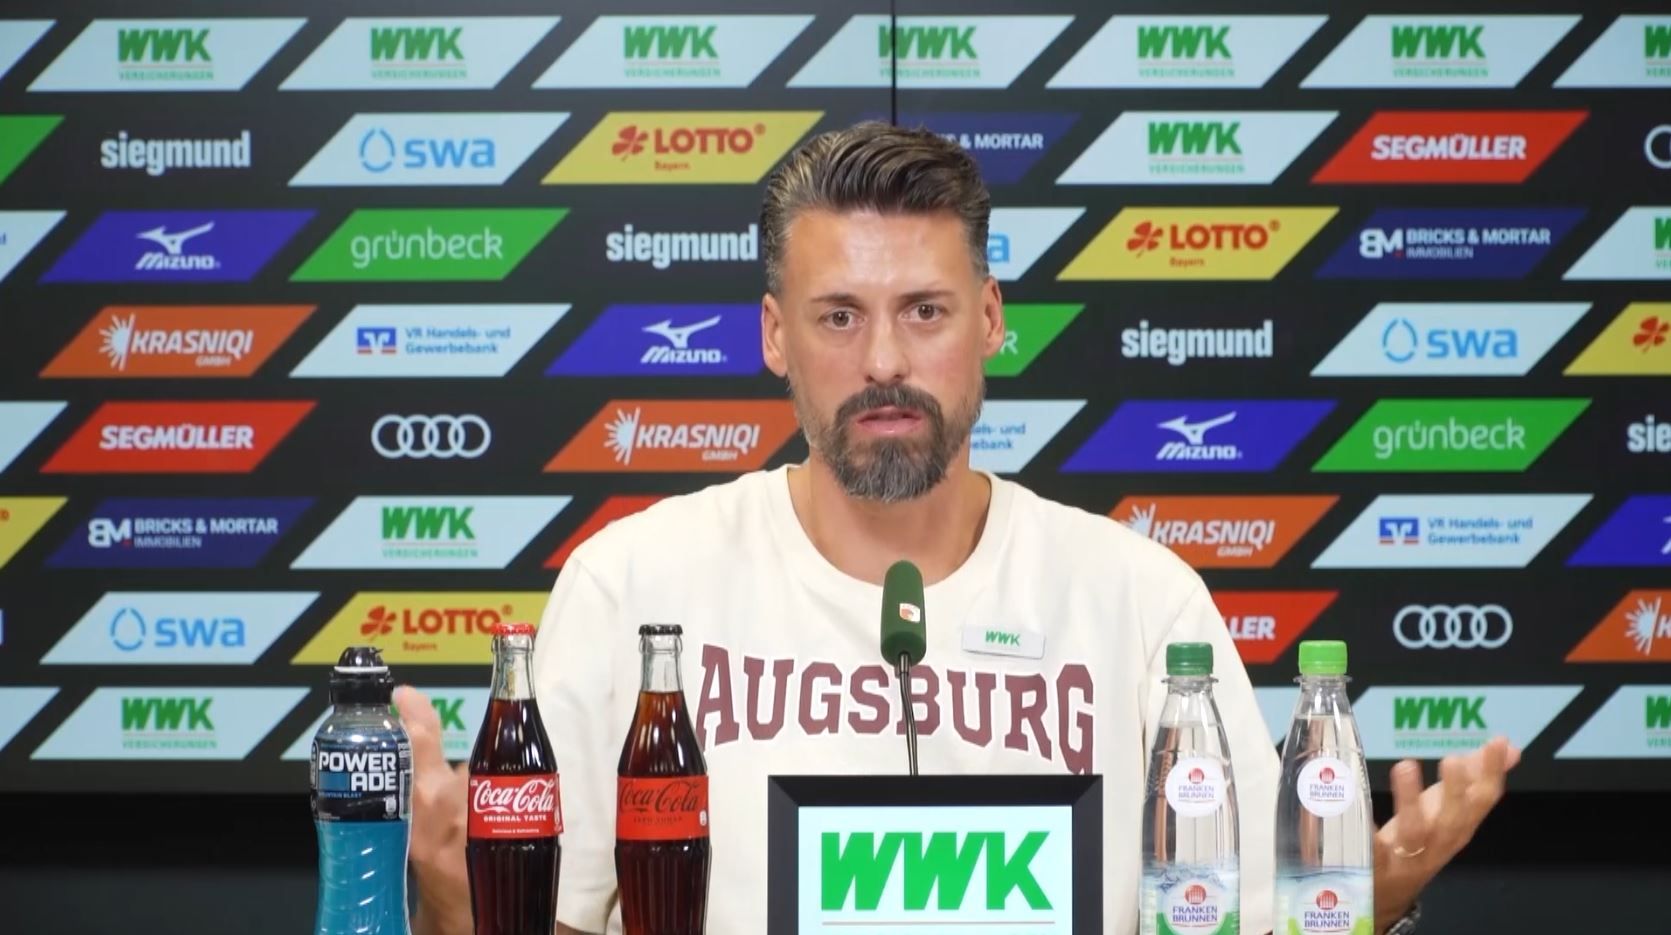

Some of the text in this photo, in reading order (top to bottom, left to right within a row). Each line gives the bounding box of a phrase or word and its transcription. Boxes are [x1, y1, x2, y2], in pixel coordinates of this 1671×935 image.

[118, 29, 211, 62] WWK
[370, 28, 464, 60] WWK
[624, 26, 718, 59] WWK
[878, 26, 977, 59] WWK
[1137, 26, 1231, 58] WWK
[1392, 26, 1485, 58] WWK
[100, 130, 251, 175] siegmund
[974, 133, 1044, 149] MORTAR
[1147, 122, 1241, 154] WWK
[1371, 134, 1526, 160] SEGMÜLLER
[403, 139, 495, 168] swa
[351, 229, 503, 269] grünbeck
[606, 224, 758, 269] siegmund
[1406, 229, 1551, 244] BRICKS & MORTAR
[1406, 246, 1473, 258] IMMOBILIEN
[131, 330, 253, 359] KRASNIQI
[485, 327, 510, 339] und
[1121, 320, 1273, 365] siegmund
[1427, 329, 1518, 358] swa
[100, 424, 254, 450] SEGMÜLLER
[637, 424, 760, 454] KRASNIQI
[1373, 418, 1525, 458] grünbeck
[134, 519, 278, 534] BRICKS & MORTAR
[382, 507, 475, 539] WWK
[1152, 520, 1275, 550] KRASNIQI
[1507, 517, 1533, 530] und
[134, 536, 202, 548] IMMOBILIEN
[155, 617, 245, 647] swa
[985, 631, 1021, 647] WWK
[121, 697, 214, 731] WWK
[695, 644, 1094, 776] AUGSBURG
[1394, 697, 1487, 729] WWK
[319, 752, 397, 771] POWER
[351, 772, 397, 791] ADE
[474, 779, 555, 813] Coca-Cola
[619, 780, 700, 813] Coca-Cola
[1309, 784, 1345, 792] FRANKEN
[524, 814, 547, 822] TASTE
[821, 831, 1053, 911] WWK
[1173, 906, 1217, 914] FRANKEN
[1173, 914, 1217, 922] BRUNNEN
[1304, 911, 1350, 920] FRANKEN
[1304, 920, 1350, 928] BRUNNEN
